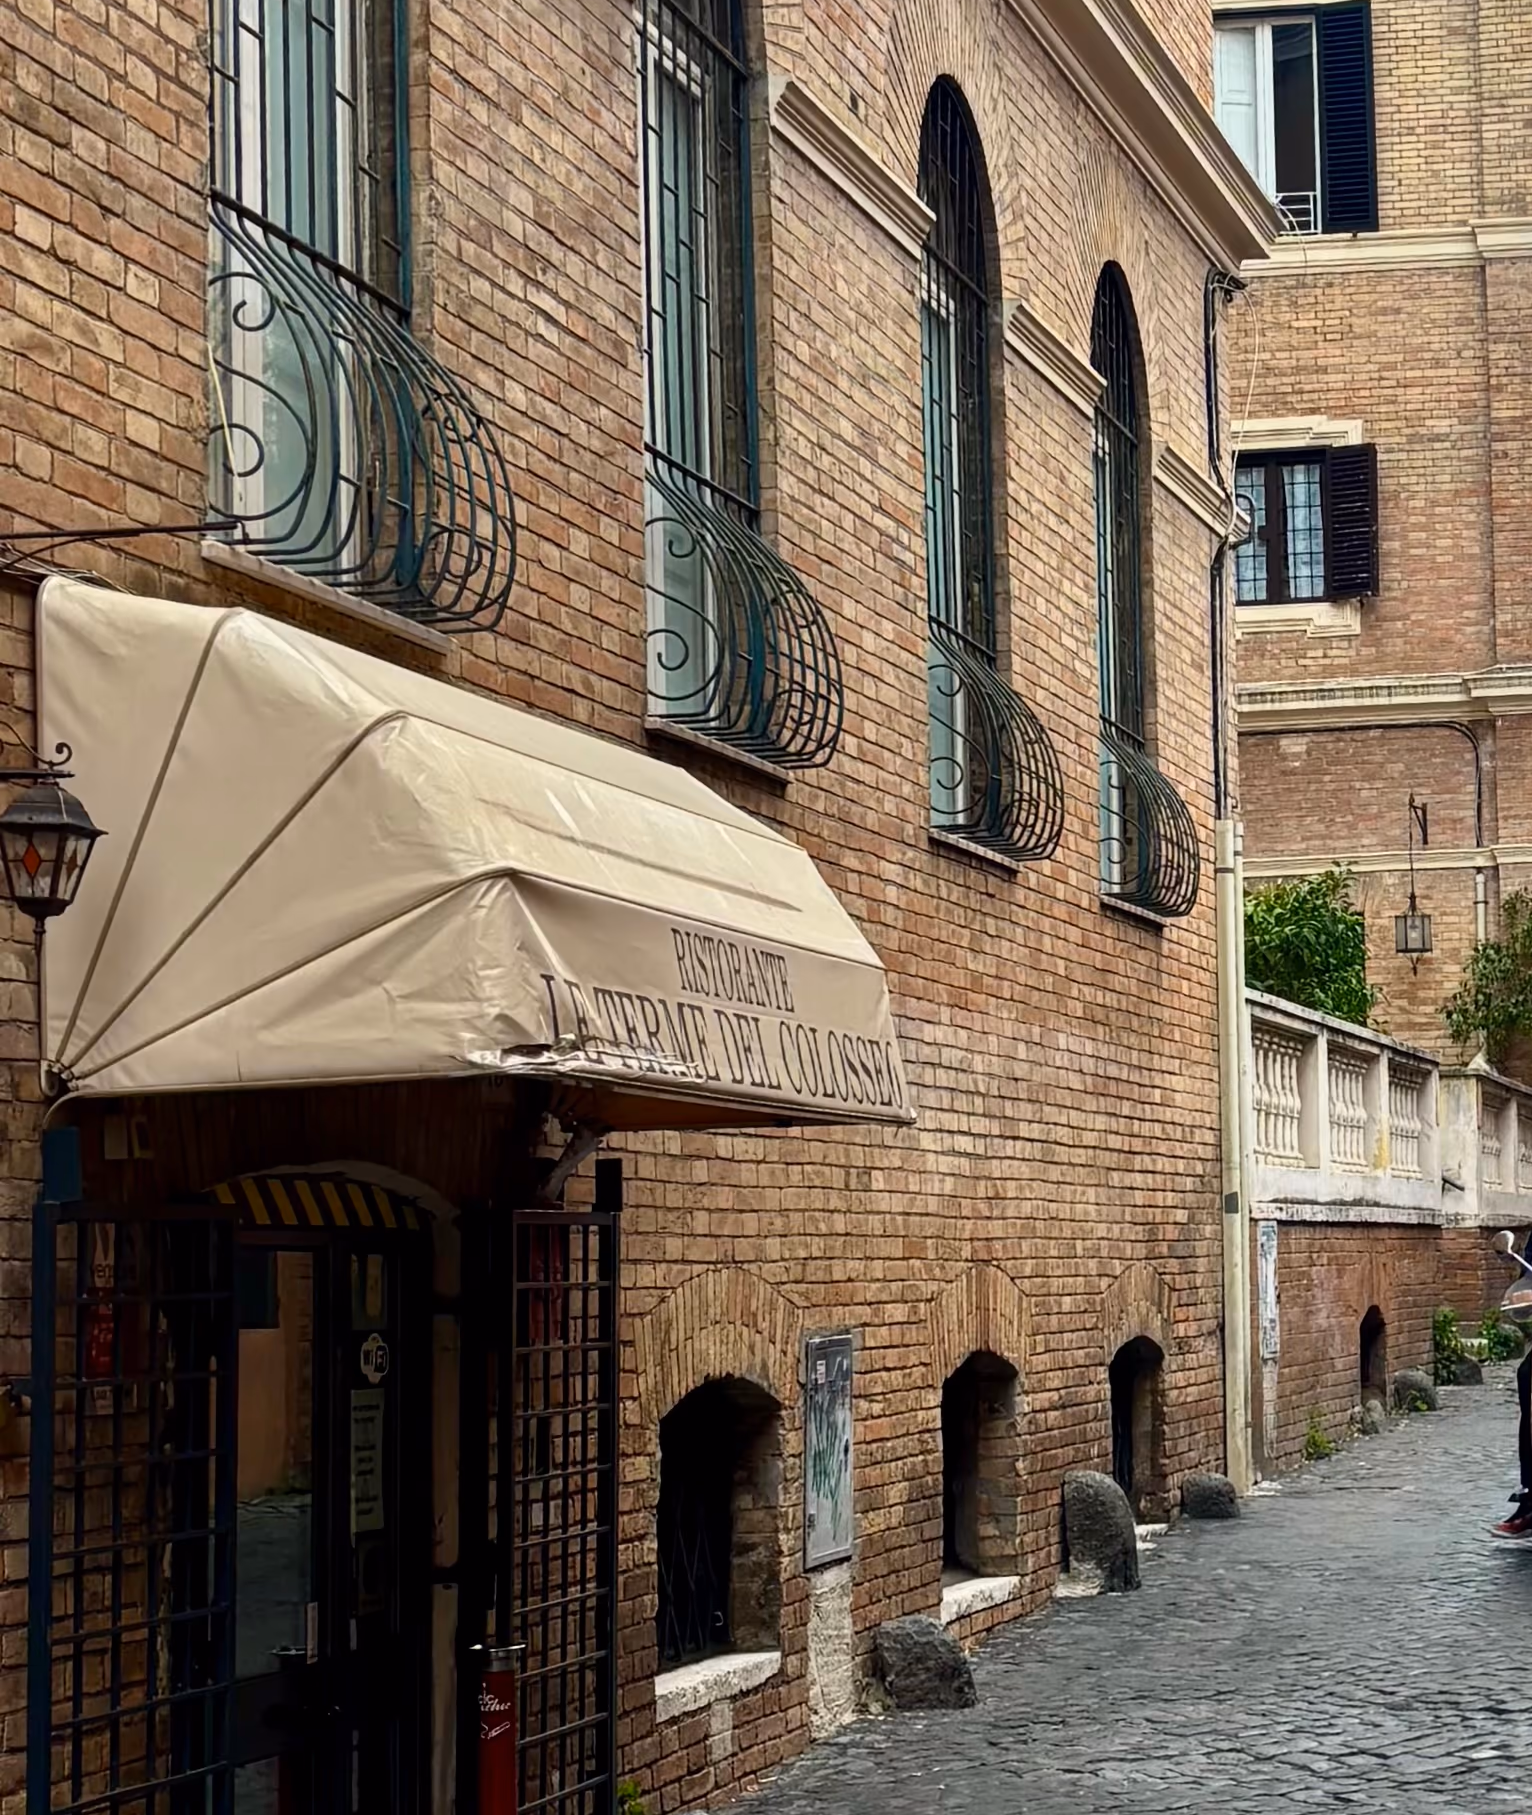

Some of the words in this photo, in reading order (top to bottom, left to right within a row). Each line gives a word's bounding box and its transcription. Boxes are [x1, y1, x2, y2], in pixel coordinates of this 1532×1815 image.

[670, 927, 795, 1013] RISTORANTE
[540, 973, 605, 1065] LE
[592, 986, 721, 1083] TERME
[713, 1008, 783, 1091] DEL
[779, 1021, 903, 1110] COLOSSEO
